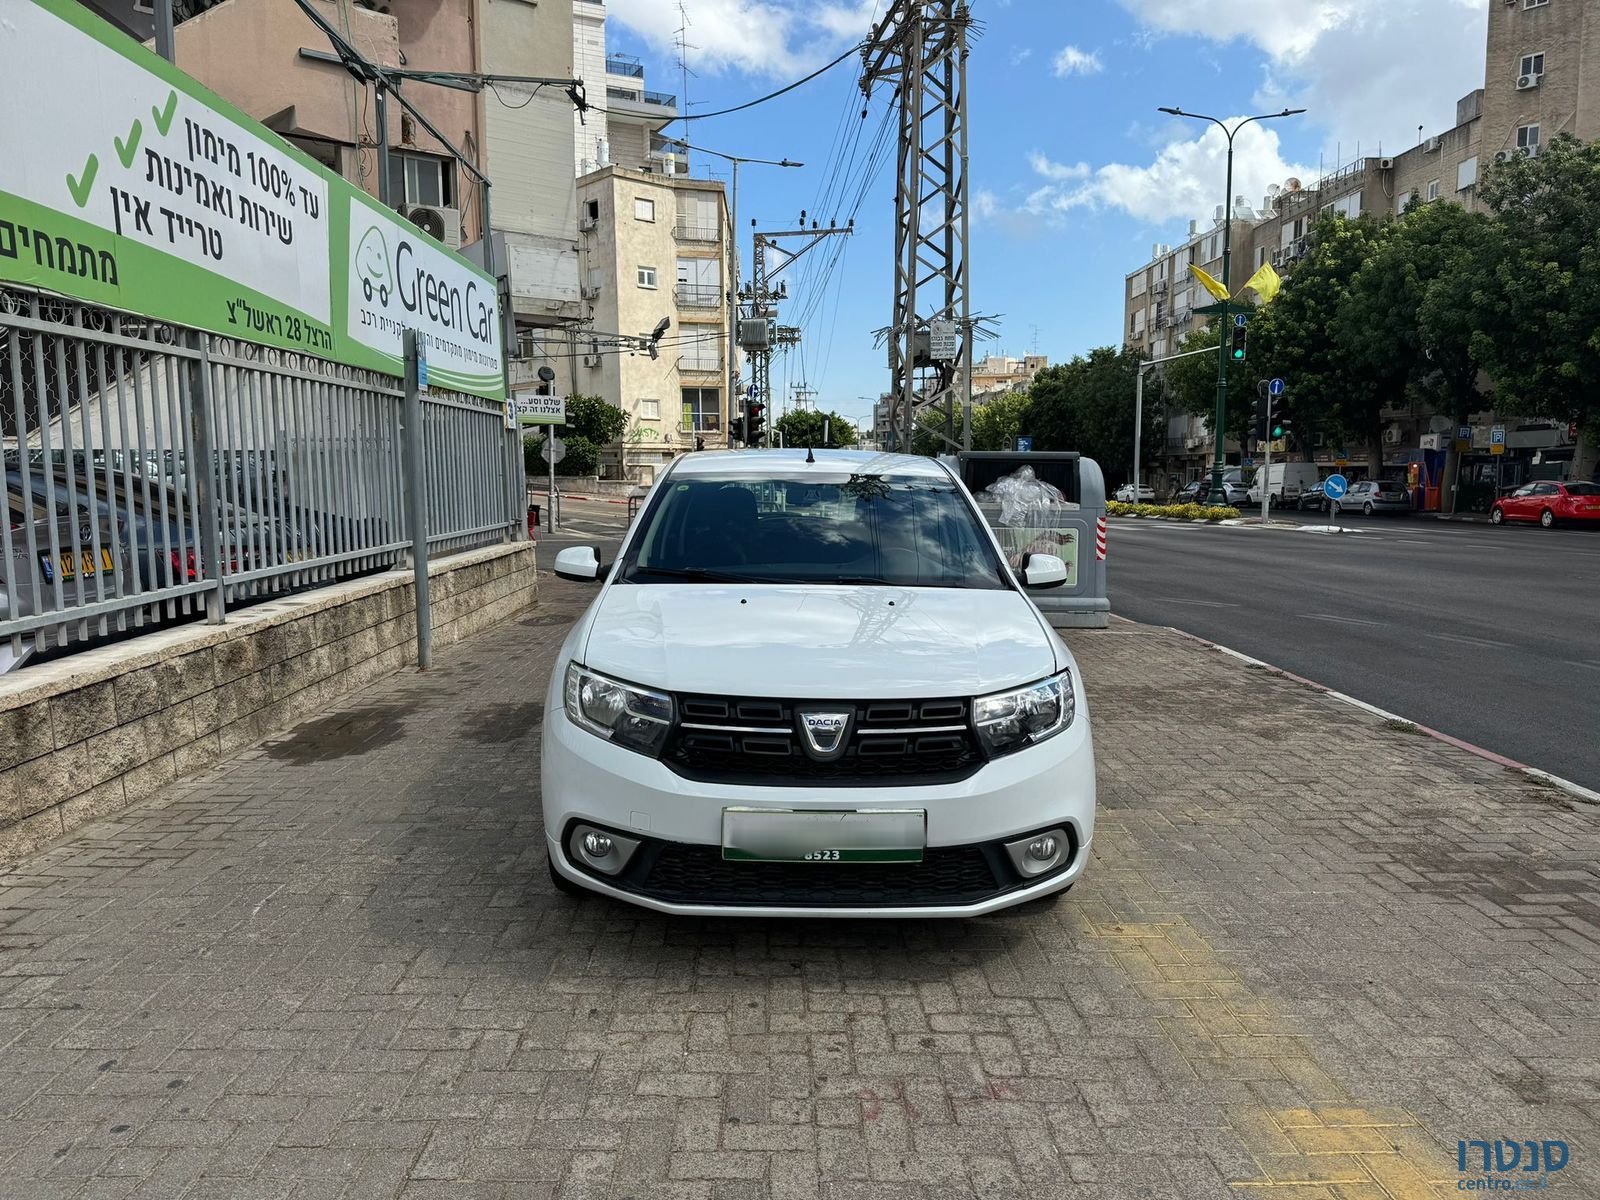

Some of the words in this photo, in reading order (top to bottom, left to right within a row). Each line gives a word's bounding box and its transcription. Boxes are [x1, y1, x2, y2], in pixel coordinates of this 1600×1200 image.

[185, 117, 241, 177] מימון
[145, 147, 233, 219] ואמינות
[247, 152, 296, 207] 100%
[299, 185, 319, 220] עד
[110, 186, 153, 236] אין
[160, 206, 223, 260] טרייד
[239, 195, 293, 245] שירות
[0, 219, 118, 286] מתמחים
[226, 298, 283, 336] ראשל"צ
[396, 240, 463, 333] Green
[466, 281, 493, 345] Car
[285, 315, 301, 341] 28
[304, 319, 332, 351] הרצל
[360, 309, 377, 328] רכב
[808, 718, 841, 727] DACIA
